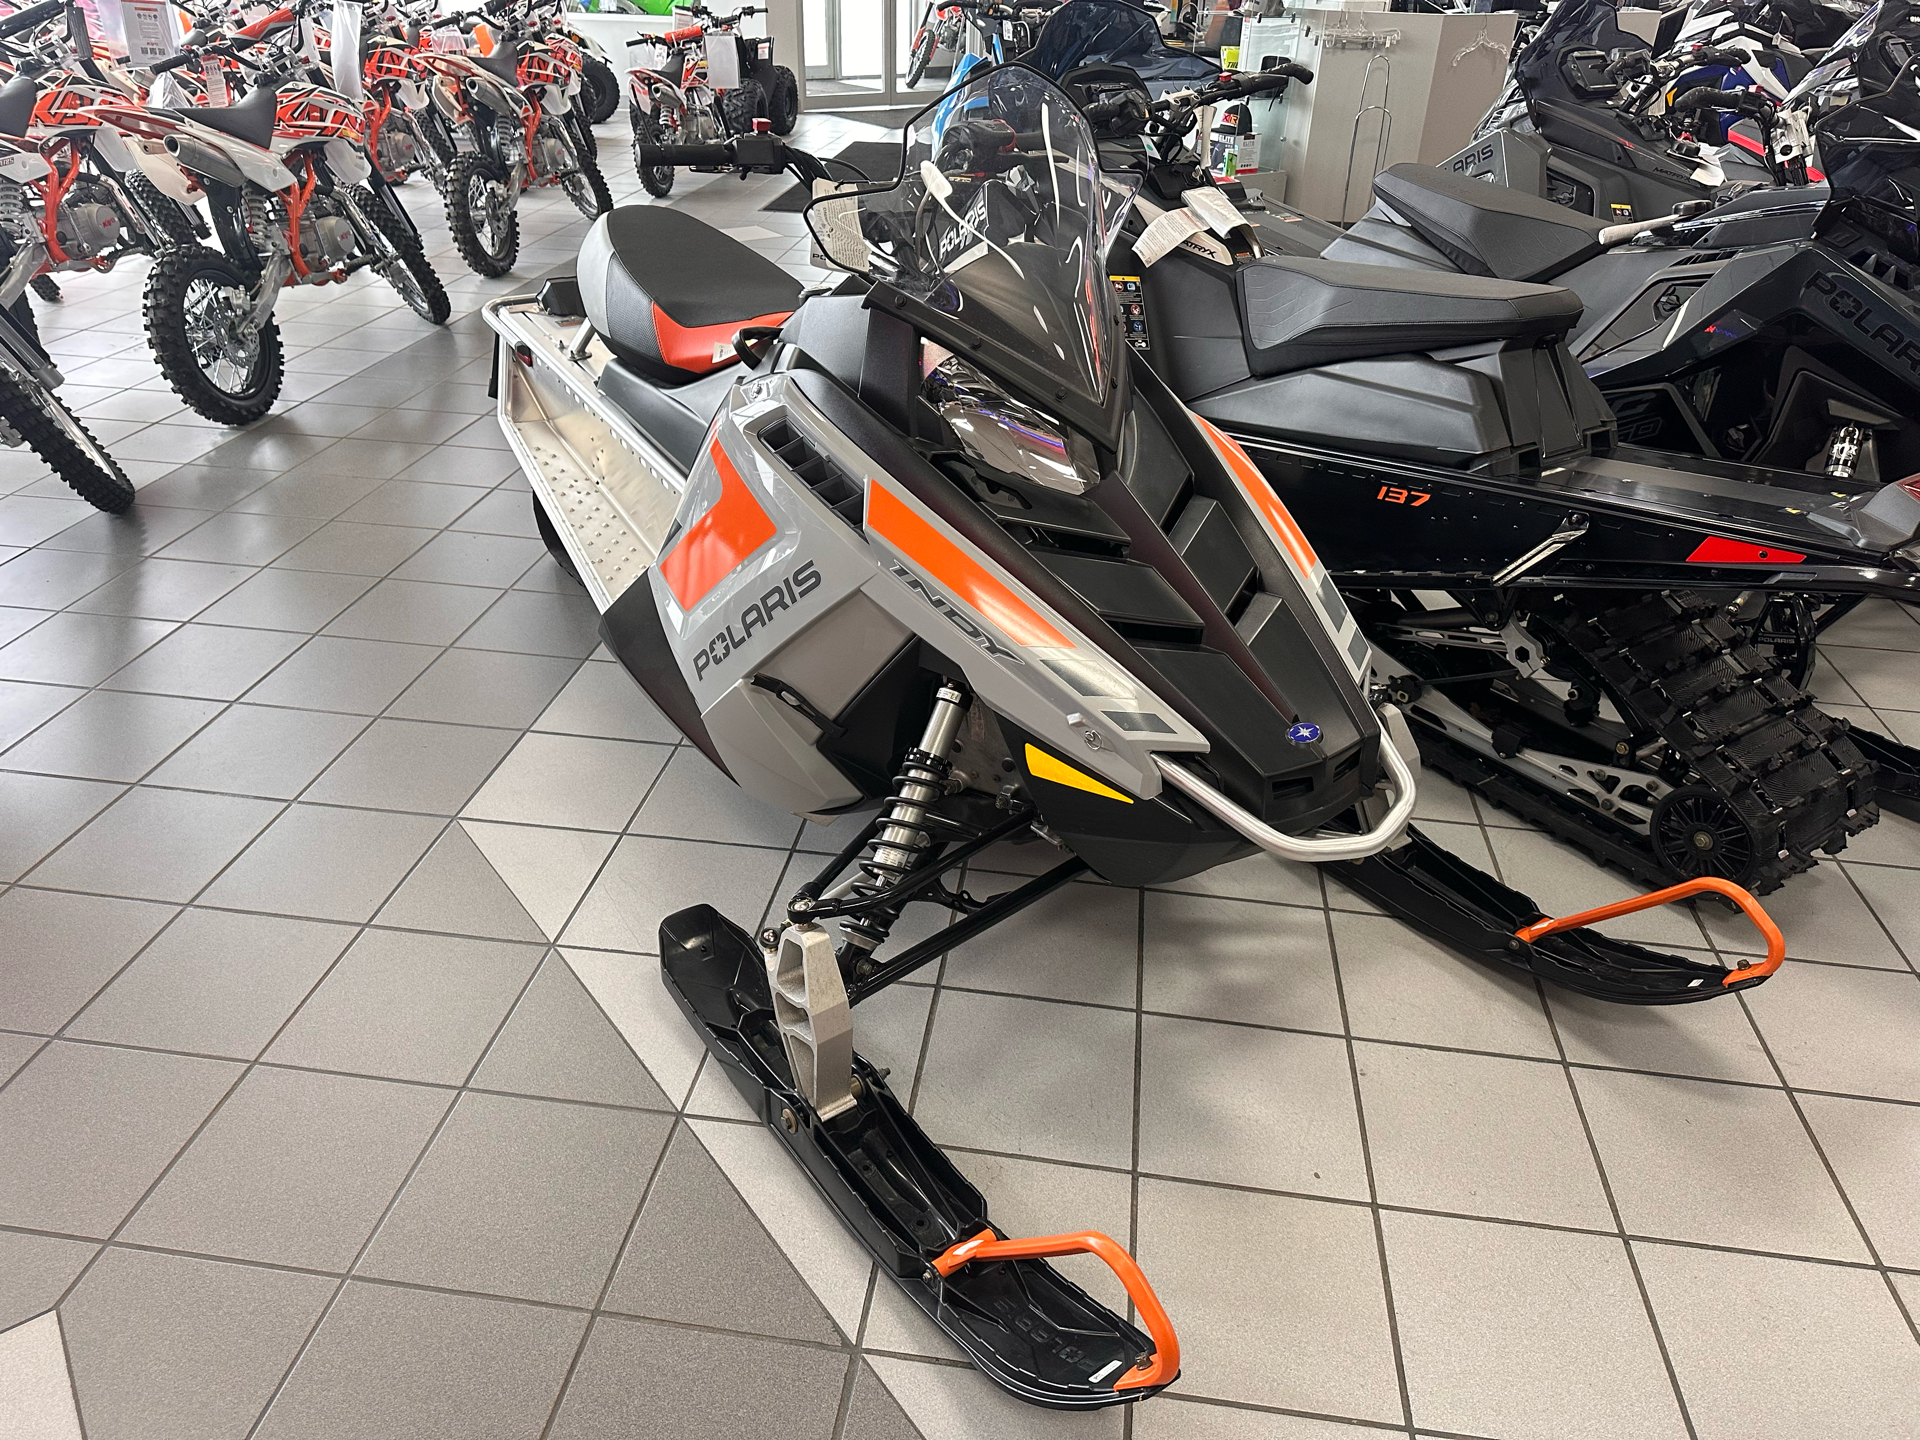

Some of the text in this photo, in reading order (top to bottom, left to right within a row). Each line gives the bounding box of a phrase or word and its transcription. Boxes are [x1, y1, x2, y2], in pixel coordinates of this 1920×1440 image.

[1452, 143, 1494, 173] ARIS
[939, 199, 987, 262] POLARIS
[1180, 240, 1217, 259] ATRYX
[1802, 269, 1920, 377] POLAR
[1376, 485, 1432, 507] 137
[692, 558, 822, 682] POLARIS
[889, 558, 1026, 665] INDY
[1757, 636, 1796, 644] POLARIS
